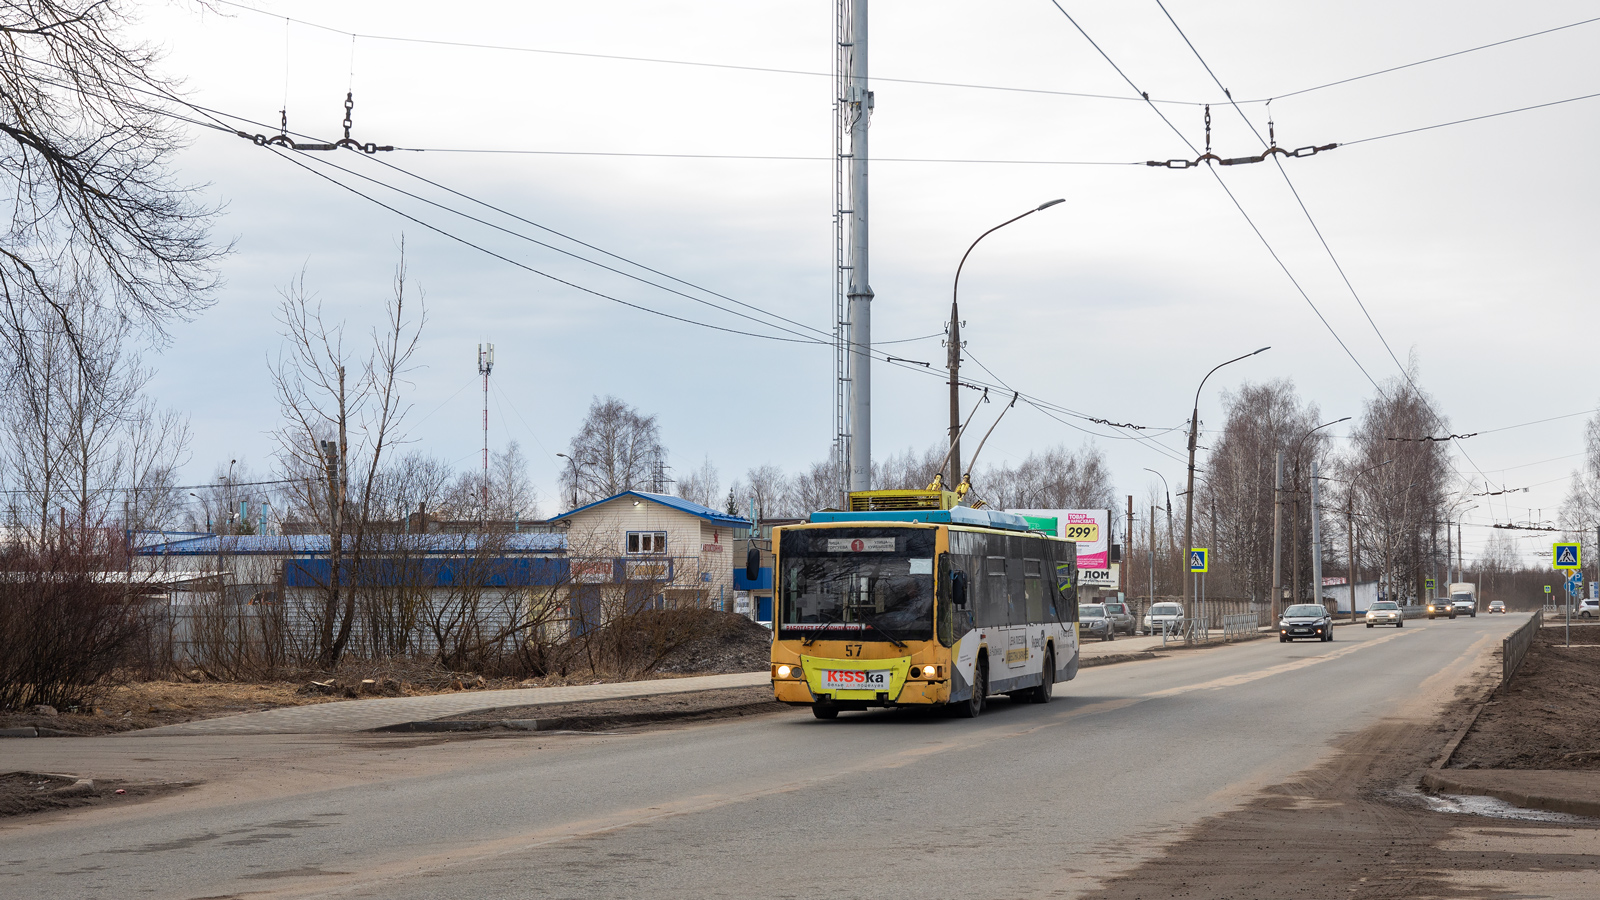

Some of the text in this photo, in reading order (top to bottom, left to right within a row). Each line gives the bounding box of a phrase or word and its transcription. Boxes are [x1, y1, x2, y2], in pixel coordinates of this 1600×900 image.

[1068, 527, 1090, 538] 299
[854, 540, 860, 550] 1
[1084, 570, 1109, 579] ЛОМ
[846, 644, 862, 657] 57
